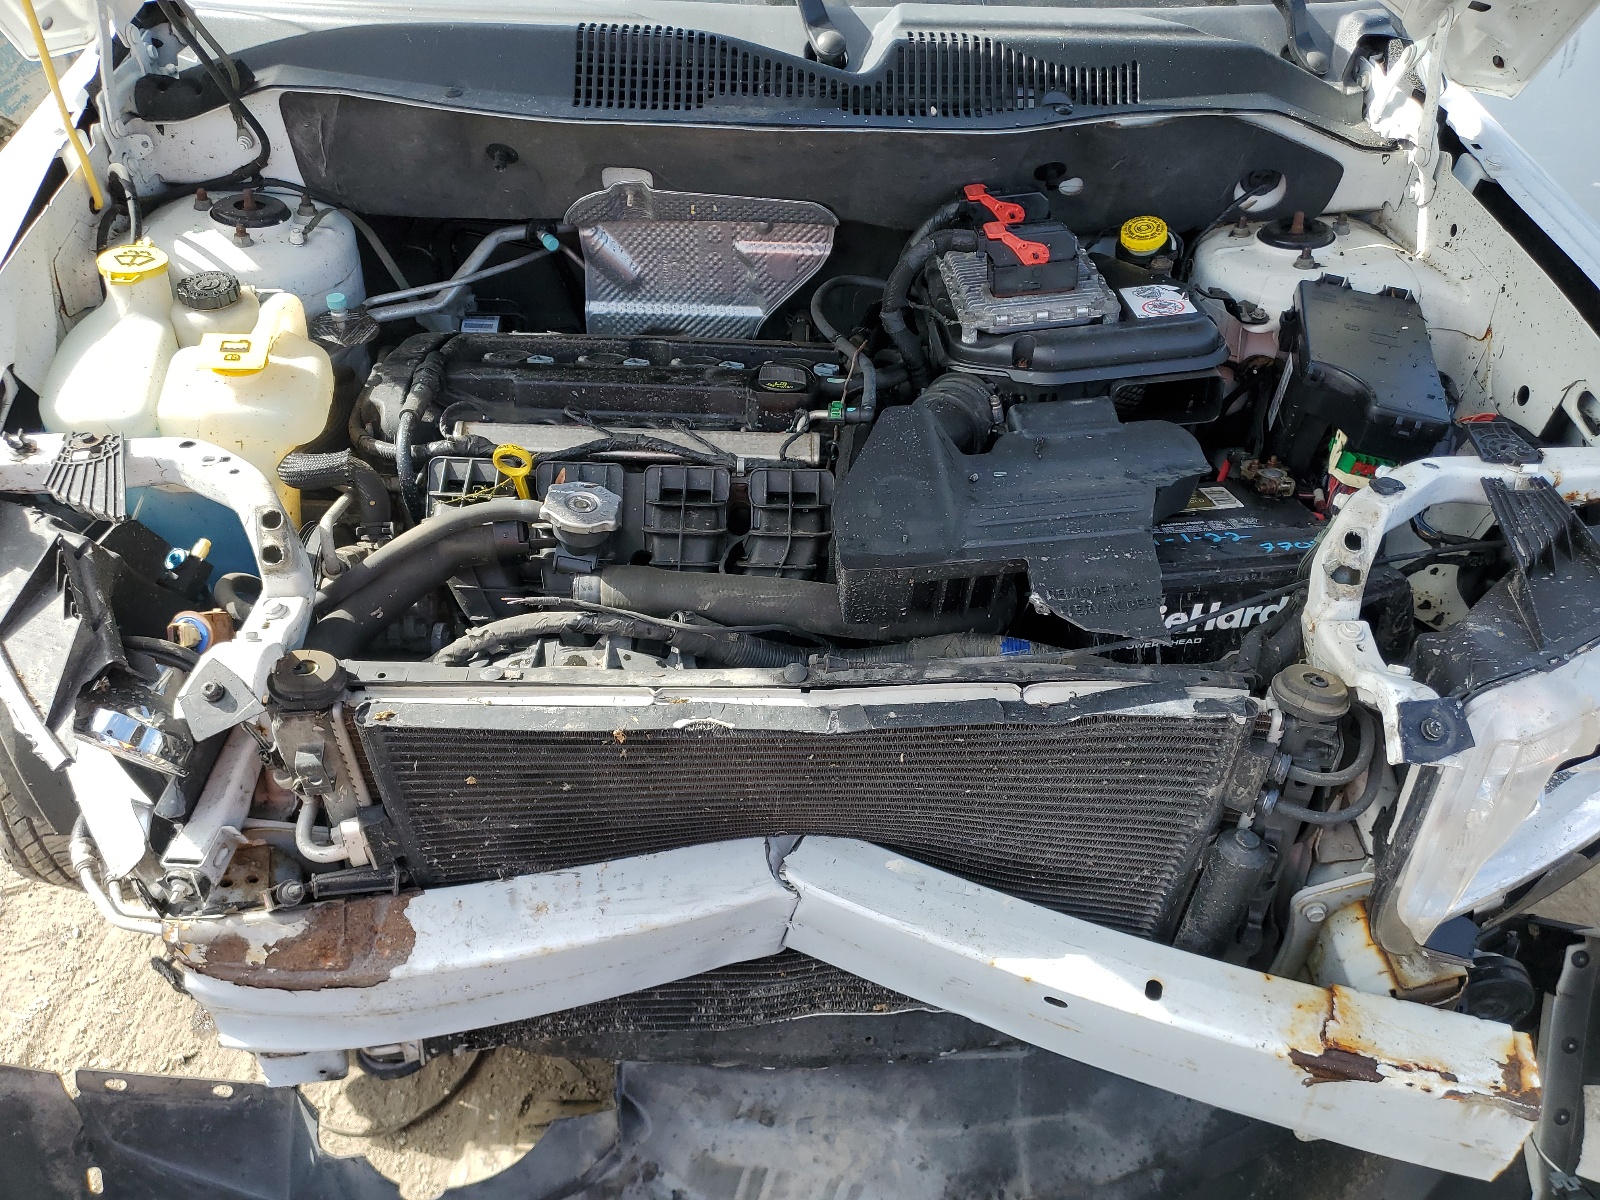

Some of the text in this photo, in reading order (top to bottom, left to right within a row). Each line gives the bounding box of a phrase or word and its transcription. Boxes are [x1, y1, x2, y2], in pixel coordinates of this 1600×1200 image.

[1154, 533, 1252, 546] -1-22
[1160, 596, 1290, 634] ieHard
[1126, 637, 1202, 650] OWER HEAD
